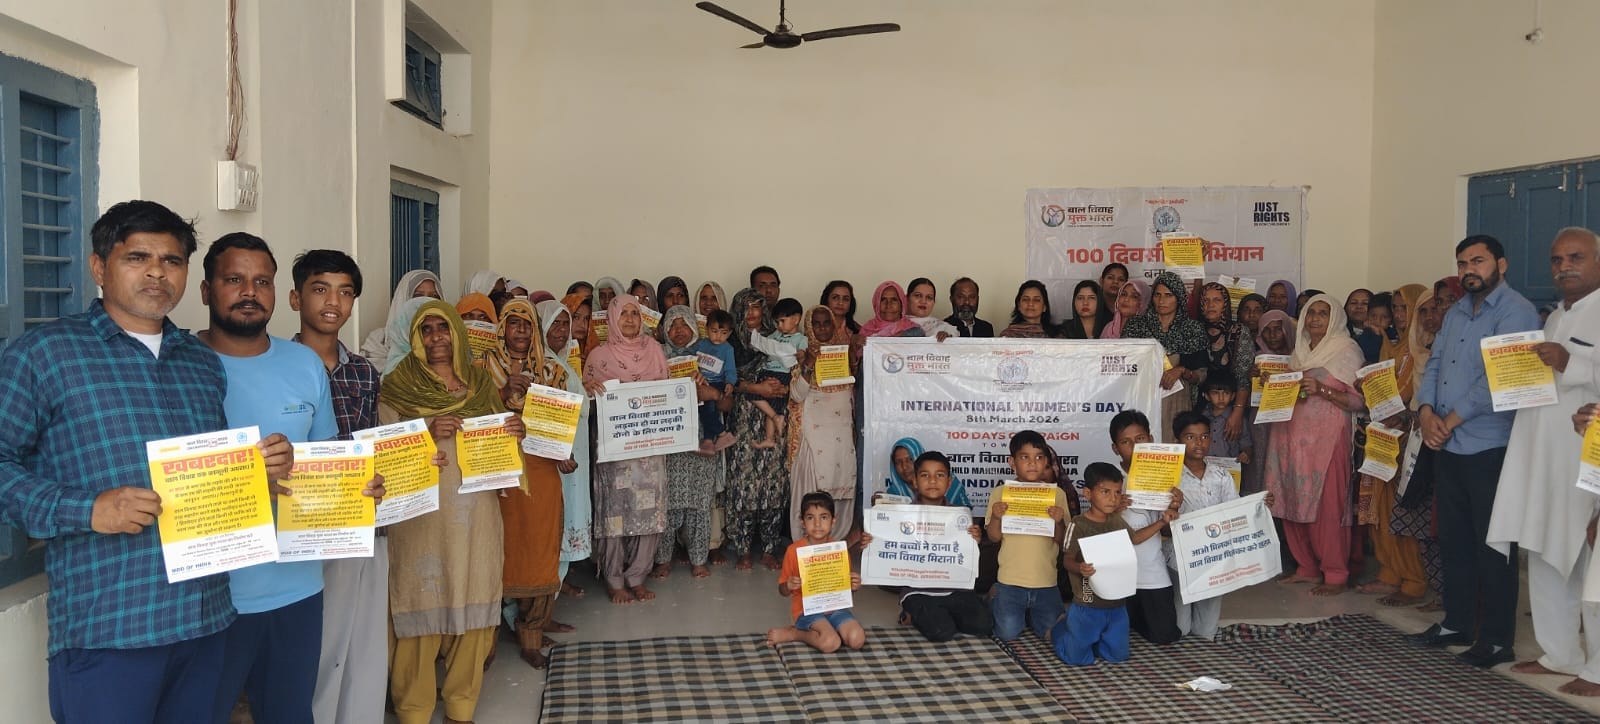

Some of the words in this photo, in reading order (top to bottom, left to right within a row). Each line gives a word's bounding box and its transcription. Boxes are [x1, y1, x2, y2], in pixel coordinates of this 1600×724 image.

[1088, 204, 1114, 213] विवाह
[1254, 202, 1278, 212] JUST
[1068, 214, 1087, 224] मुक्त
[1089, 214, 1113, 222] भारत
[1253, 212, 1290, 222] RIGHTS
[1066, 248, 1104, 264] 100
[1108, 243, 1164, 264] दिवसी
[1206, 241, 1265, 262] भियान
[926, 353, 951, 362] विवाह
[1101, 355, 1126, 364] JUST
[927, 362, 951, 370] भारत
[1100, 364, 1138, 373] RIGHTS
[901, 400, 1014, 412] INTERNATIONAL
[1018, 402, 1091, 412] WOMEN'S
[1095, 402, 1125, 413] DAY
[609, 415, 626, 423] बाल
[628, 411, 651, 421] विवाह
[652, 408, 677, 418] अपराध
[966, 414, 986, 423] 8th
[989, 414, 1026, 423] March
[1028, 415, 1060, 423] 2026
[615, 421, 639, 430] लड़का
[660, 415, 683, 426] लड़की
[633, 428, 640, 437] के
[642, 426, 656, 436] लिए
[946, 431, 969, 440] 100
[971, 432, 1006, 441] DAYS
[161, 448, 255, 476] खबरदार!
[947, 453, 975, 463] बाल
[978, 451, 1011, 463] विवा
[951, 467, 969, 475] HILD
[971, 467, 1016, 475] MARRIAGE
[884, 540, 897, 549] हम
[899, 539, 921, 551] बच्चों
[922, 539, 930, 551] ने
[932, 542, 951, 551] ठाना
[953, 540, 960, 553] है
[1191, 546, 1208, 557] आओ
[878, 550, 897, 560] बाल
[899, 551, 926, 564] विवाह
[927, 552, 955, 564] मिटाना
[957, 553, 964, 566] है
[1189, 559, 1204, 568] बाल
[1204, 554, 1223, 566] विवाह
